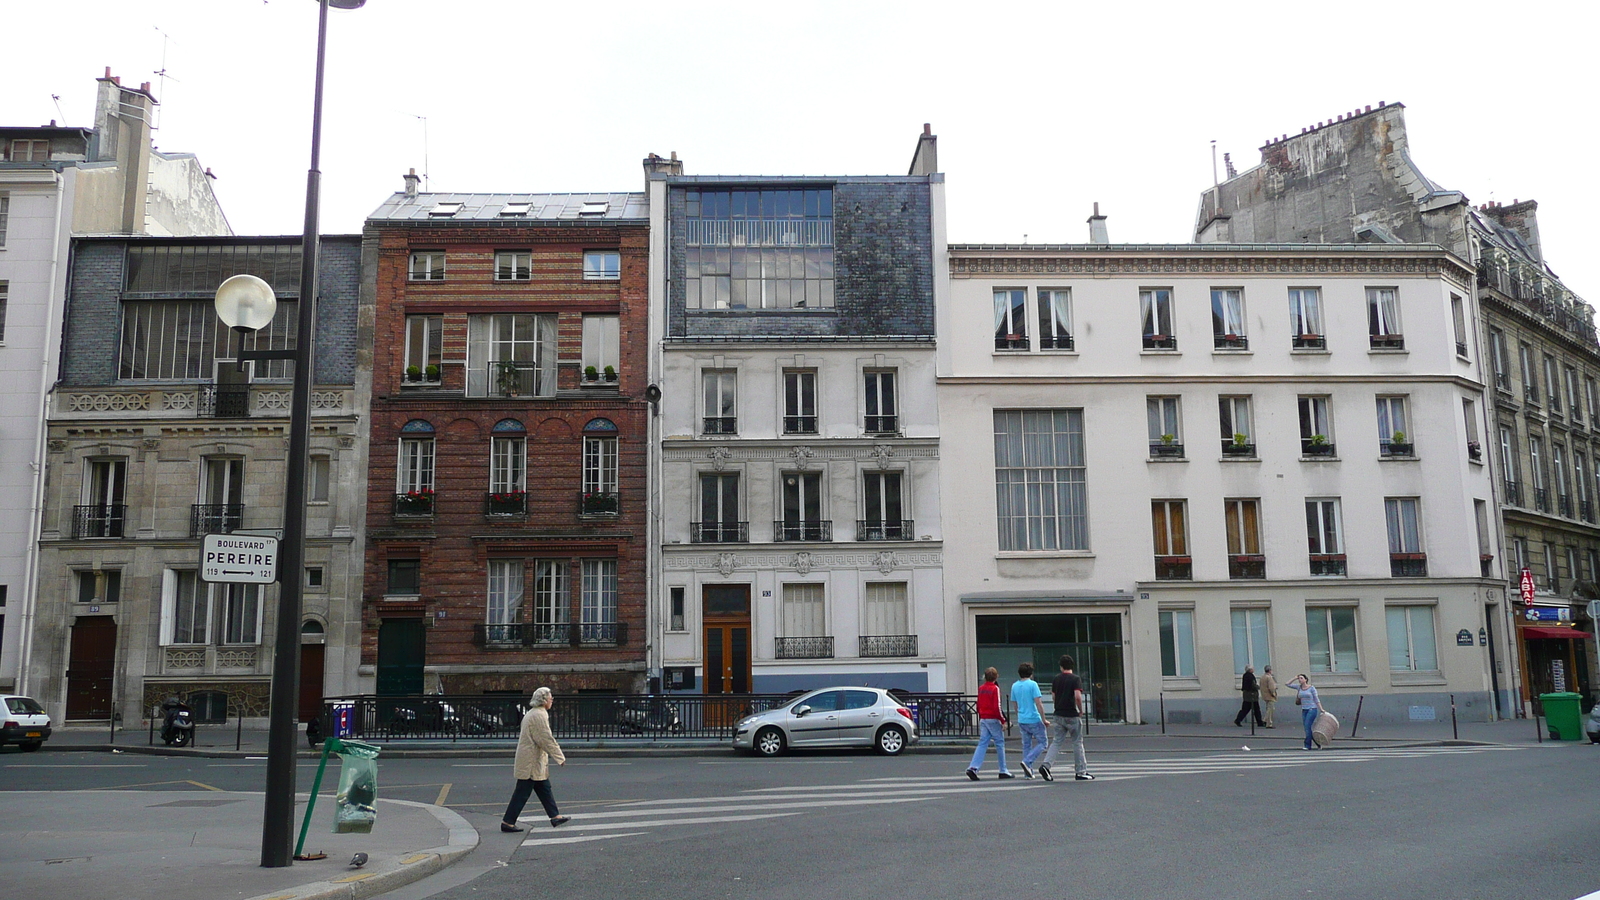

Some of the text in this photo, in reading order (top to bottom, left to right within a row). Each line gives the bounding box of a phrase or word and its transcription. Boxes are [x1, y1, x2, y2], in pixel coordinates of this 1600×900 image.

[217, 540, 265, 550] BOULEVARD
[207, 552, 273, 566] PEREIRE
[207, 568, 219, 576] 119
[1521, 569, 1531, 605] TABAC
